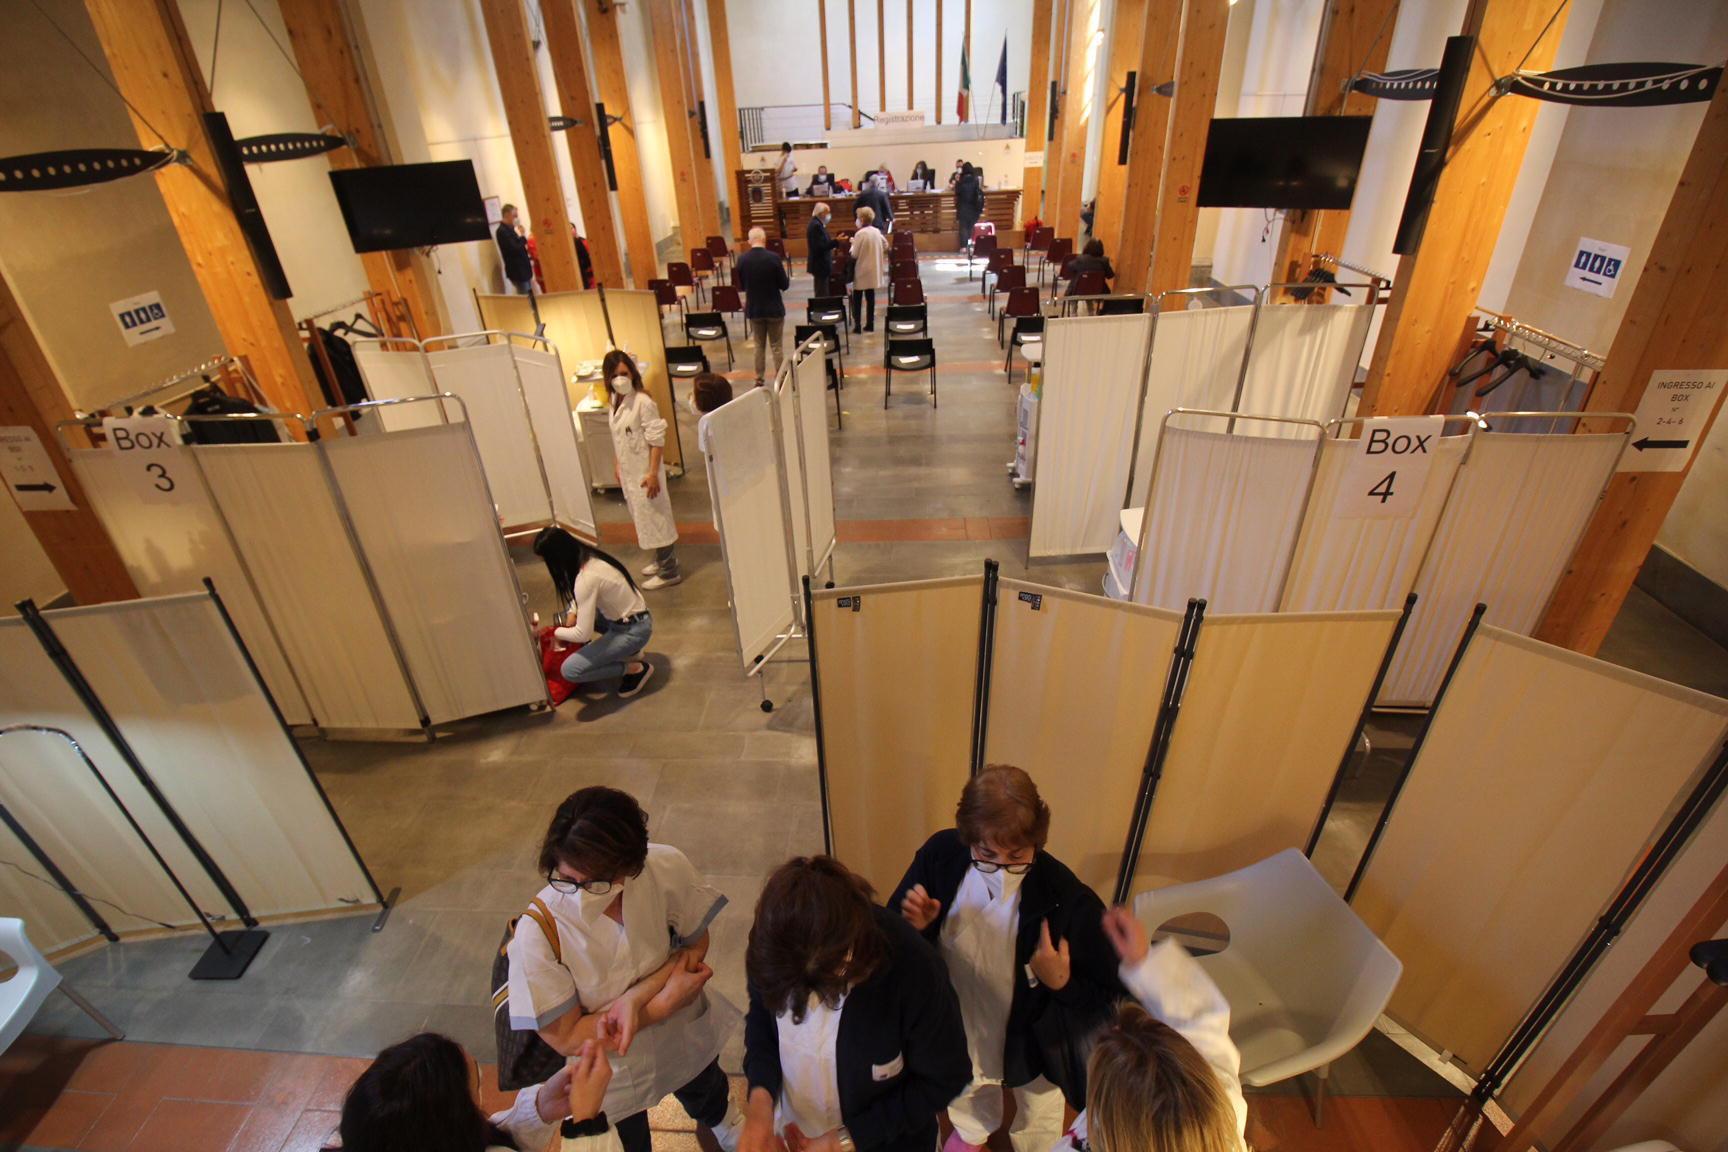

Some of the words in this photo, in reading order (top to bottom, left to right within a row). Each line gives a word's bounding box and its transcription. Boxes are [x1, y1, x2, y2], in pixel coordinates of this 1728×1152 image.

[1657, 381, 1704, 389] INGRESSO
[1670, 394, 1690, 402] BOX
[112, 427, 172, 450] Box
[1366, 428, 1432, 454] Box
[146, 463, 175, 492] 3
[1367, 470, 1397, 503] 4
